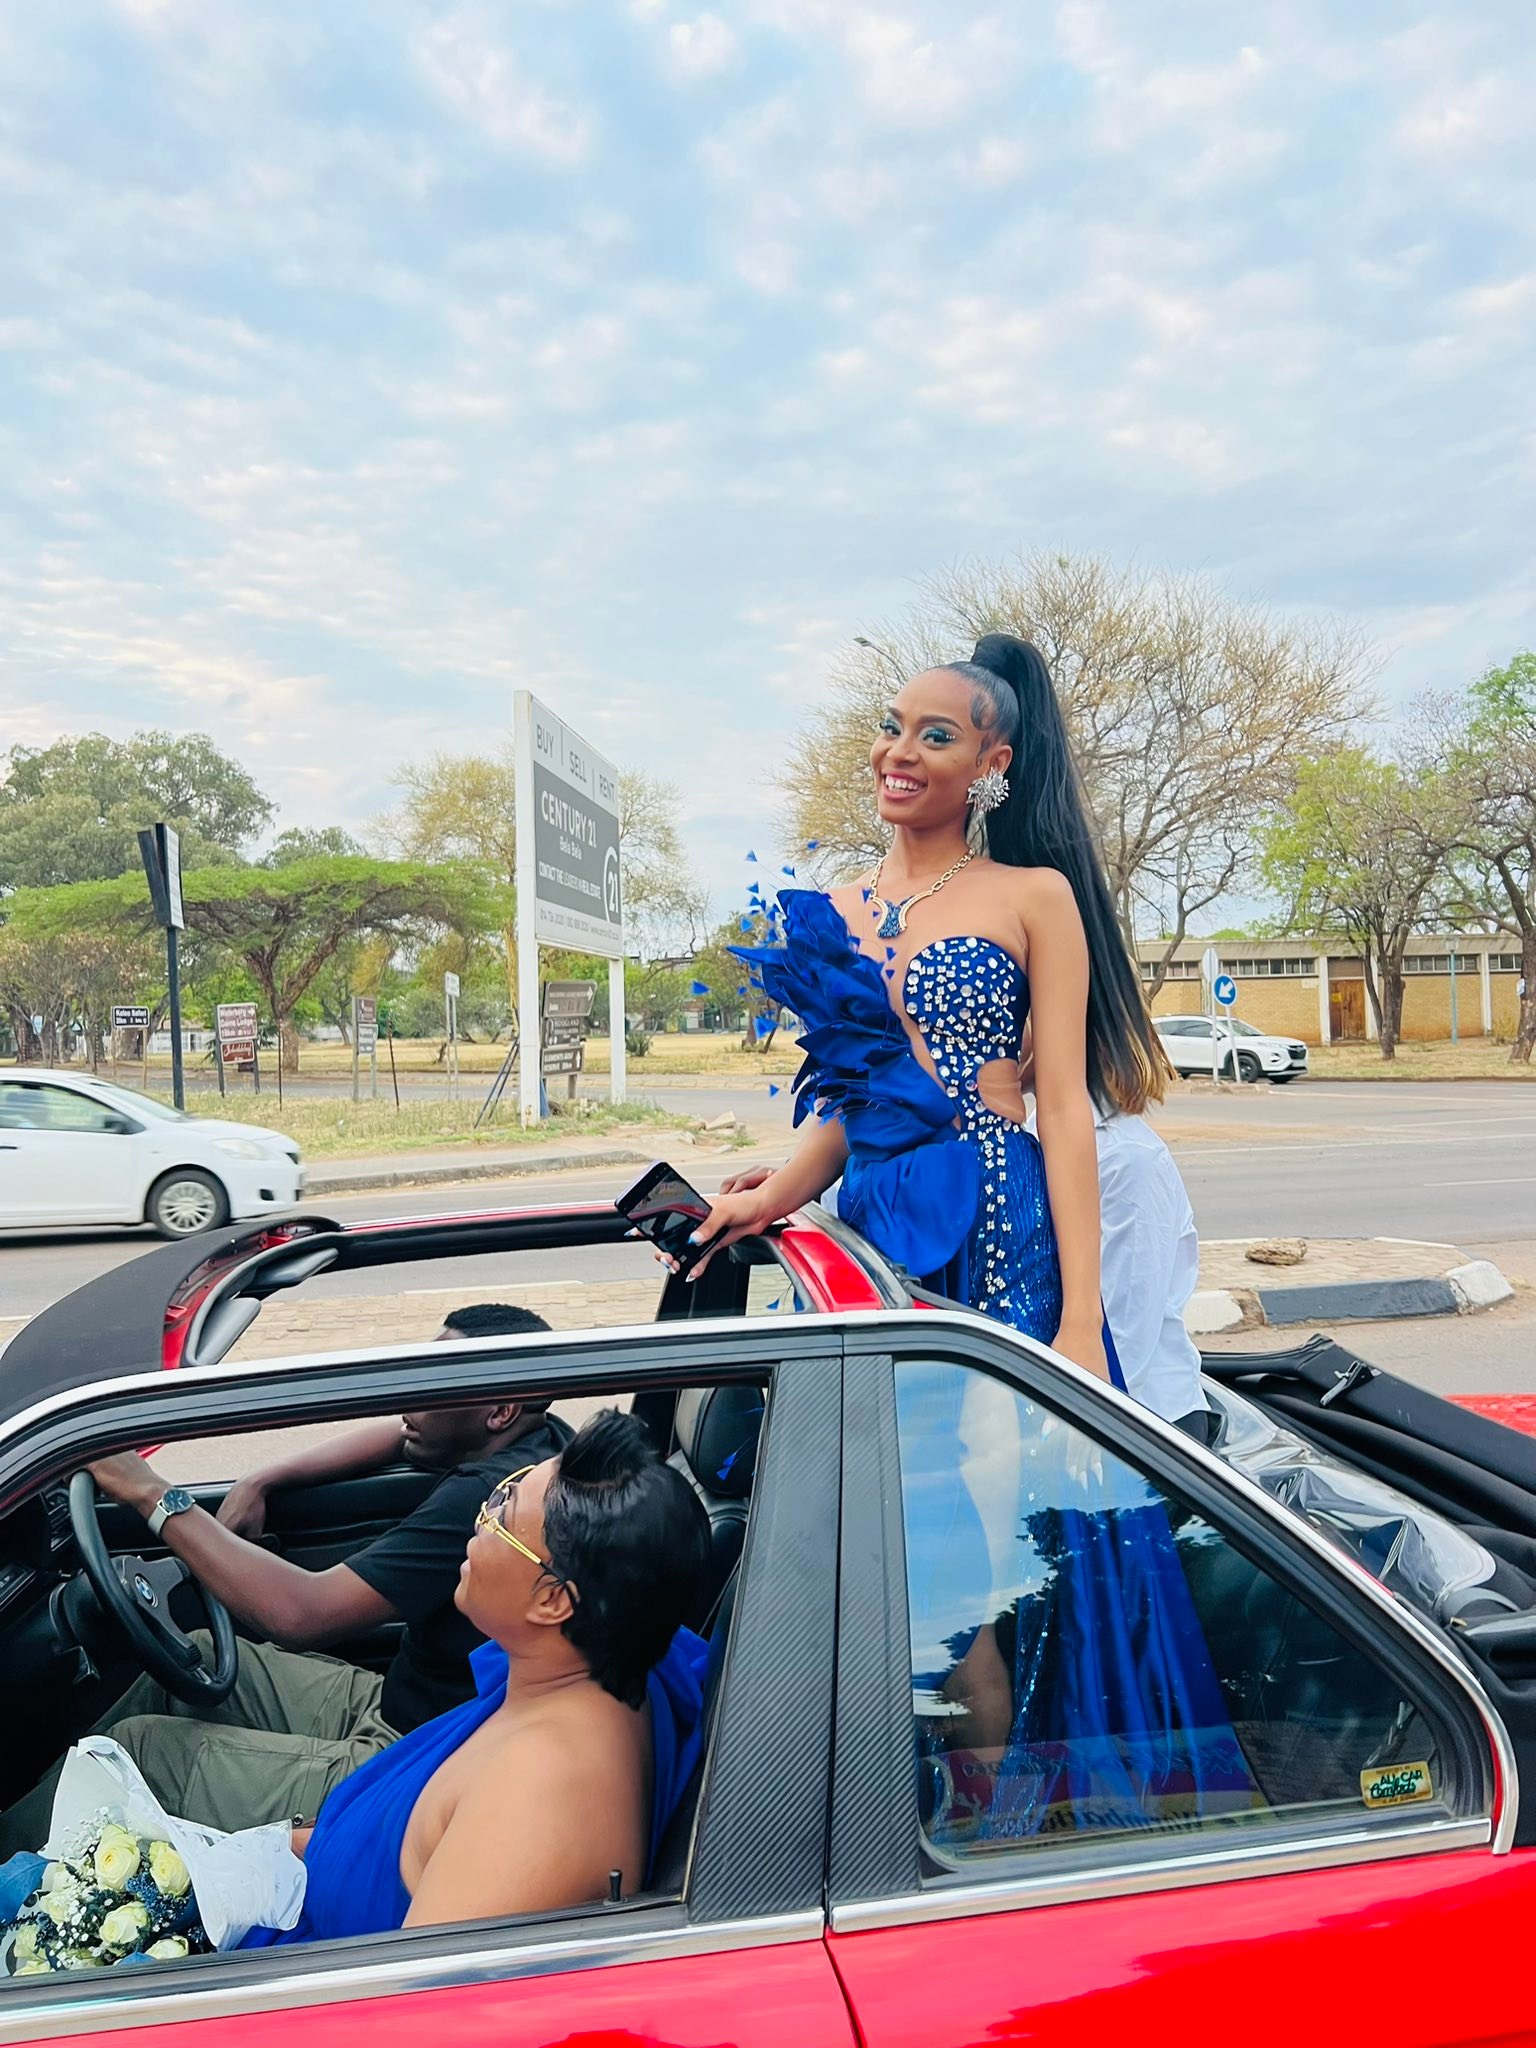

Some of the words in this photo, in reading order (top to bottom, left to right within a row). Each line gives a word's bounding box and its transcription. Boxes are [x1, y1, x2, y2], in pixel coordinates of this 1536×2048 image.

[536, 723, 554, 758] BUY
[570, 750, 587, 783] SELL
[599, 773, 615, 804] RENT
[541, 790, 587, 842] CENTURY
[588, 818, 597, 848] 21
[608, 871, 619, 913] 21
